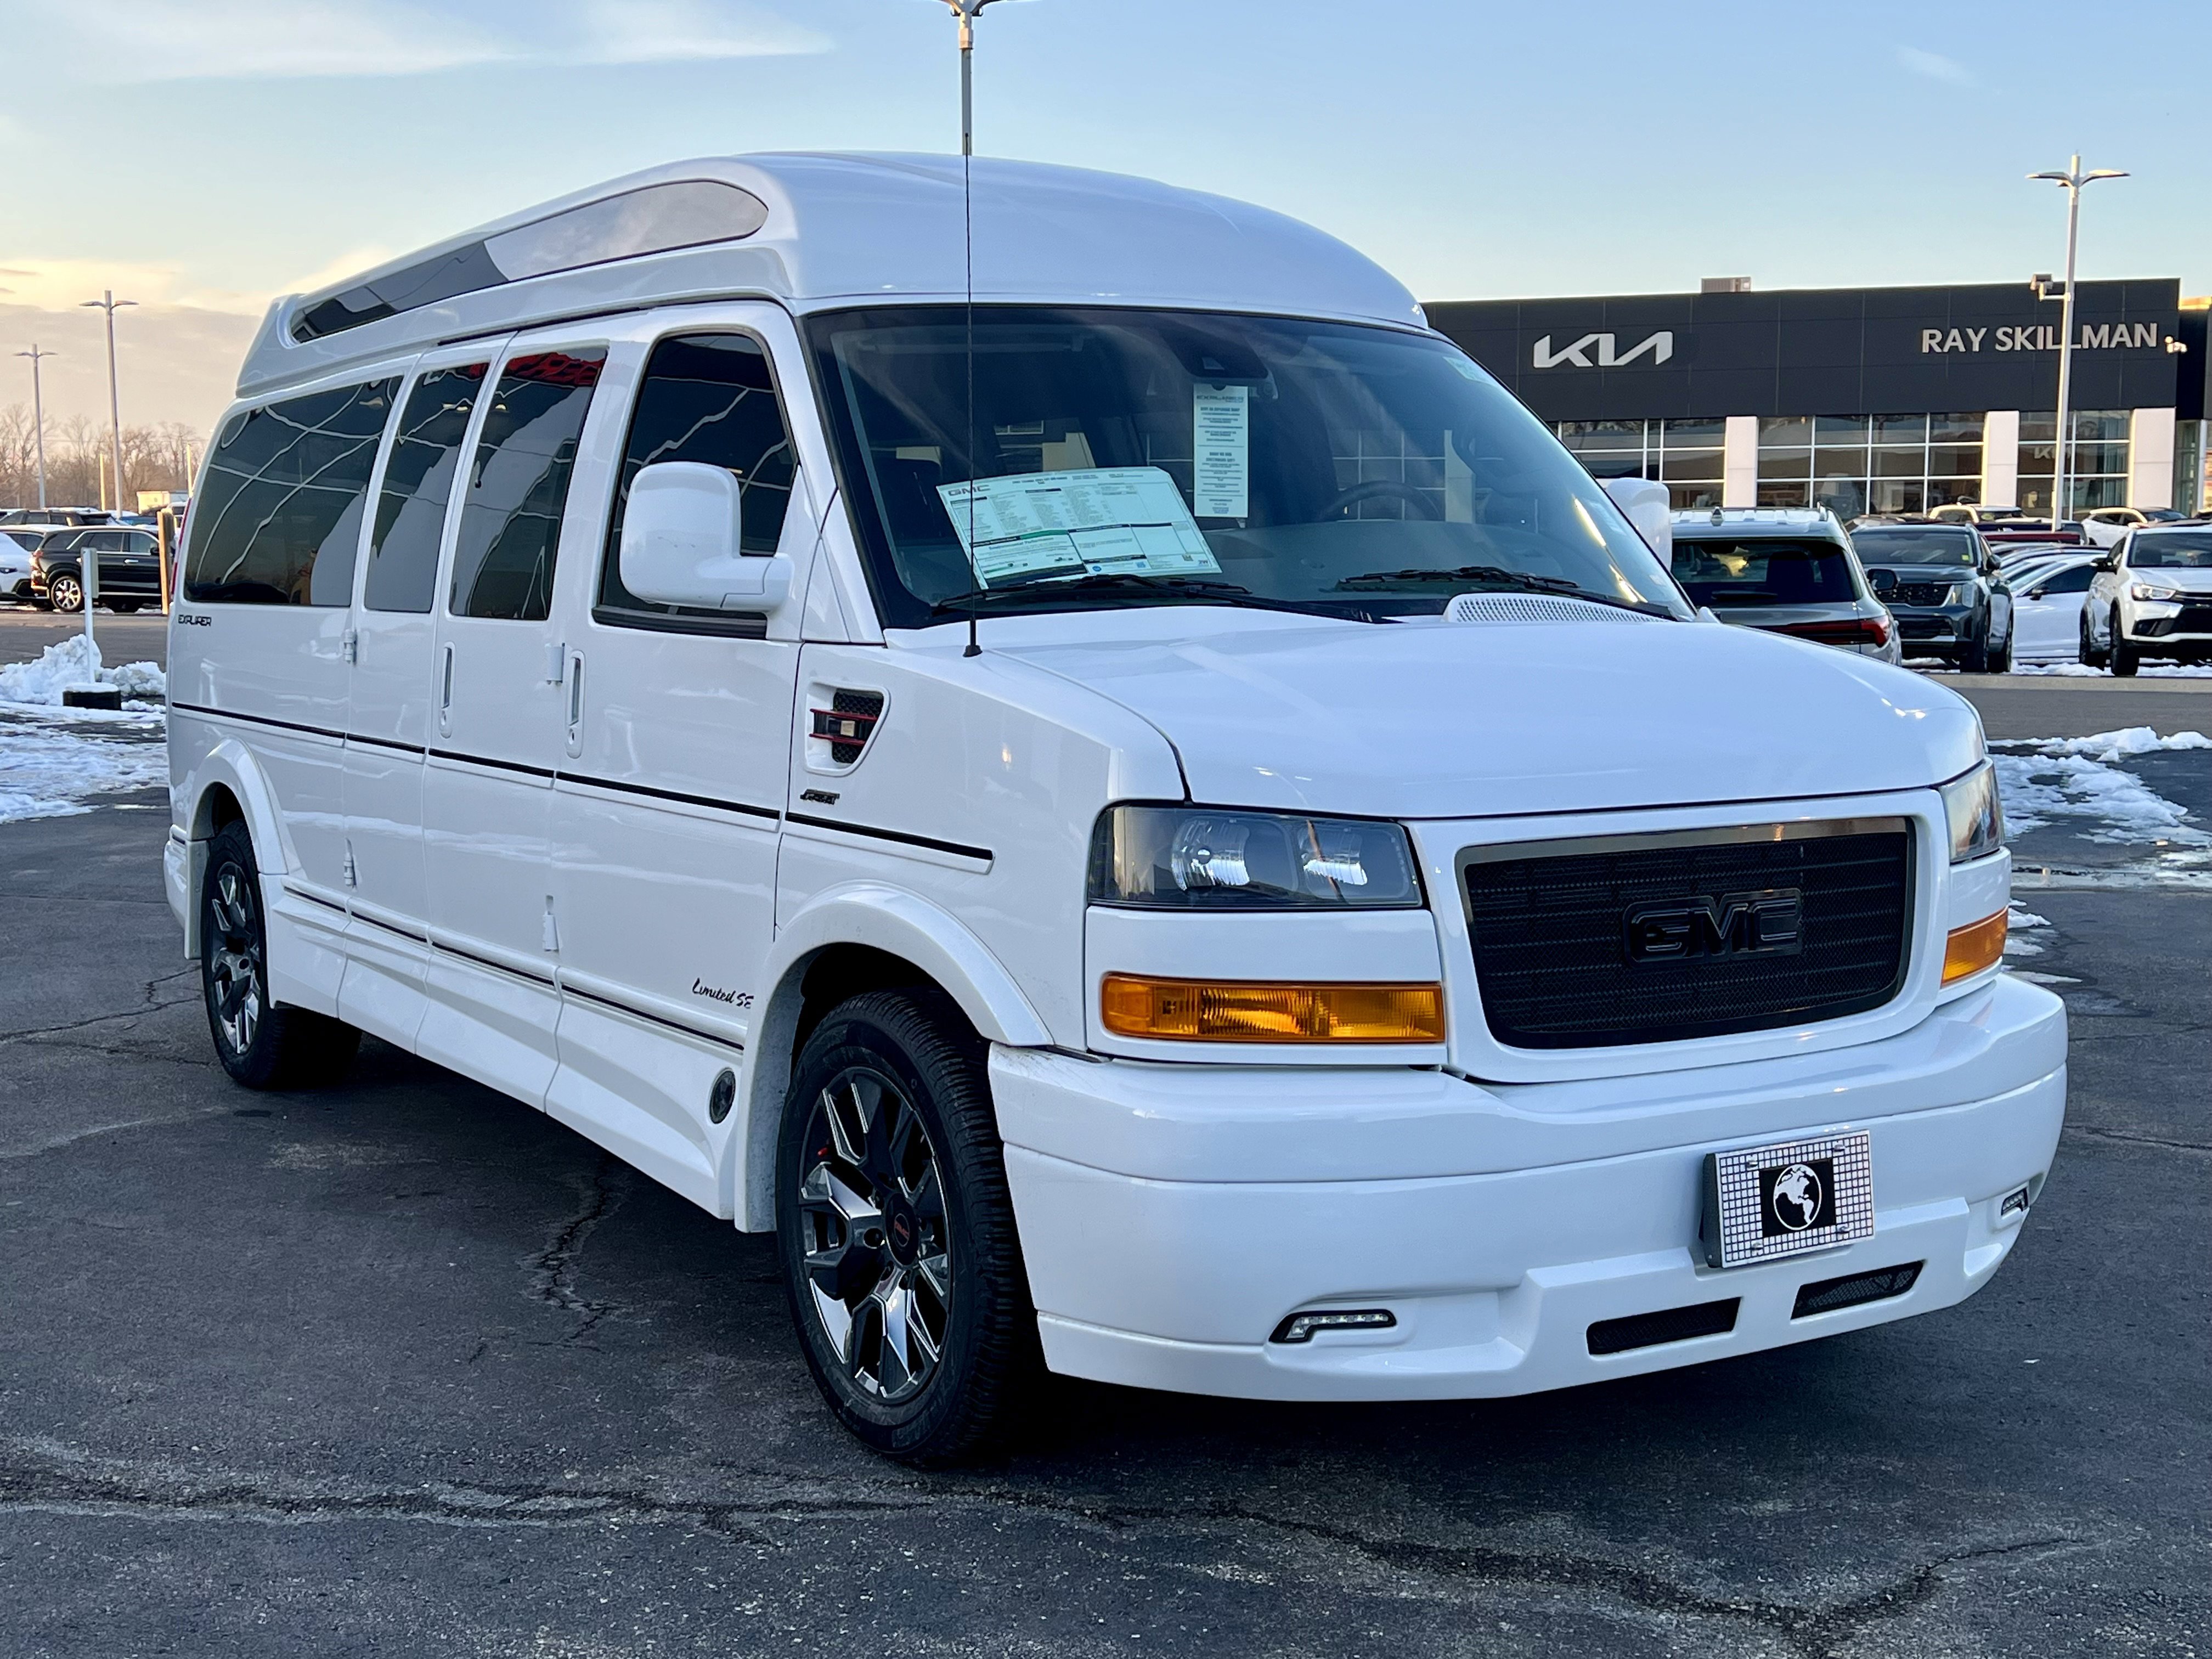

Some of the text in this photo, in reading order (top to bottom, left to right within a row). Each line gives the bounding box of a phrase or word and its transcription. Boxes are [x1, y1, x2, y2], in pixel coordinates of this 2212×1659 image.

[1533, 331, 1673, 368] KIA
[1922, 328, 1987, 353] RAY
[948, 484, 991, 496] GMC
[1630, 895, 1798, 962] GMC
[692, 978, 754, 1009] Limited SE
